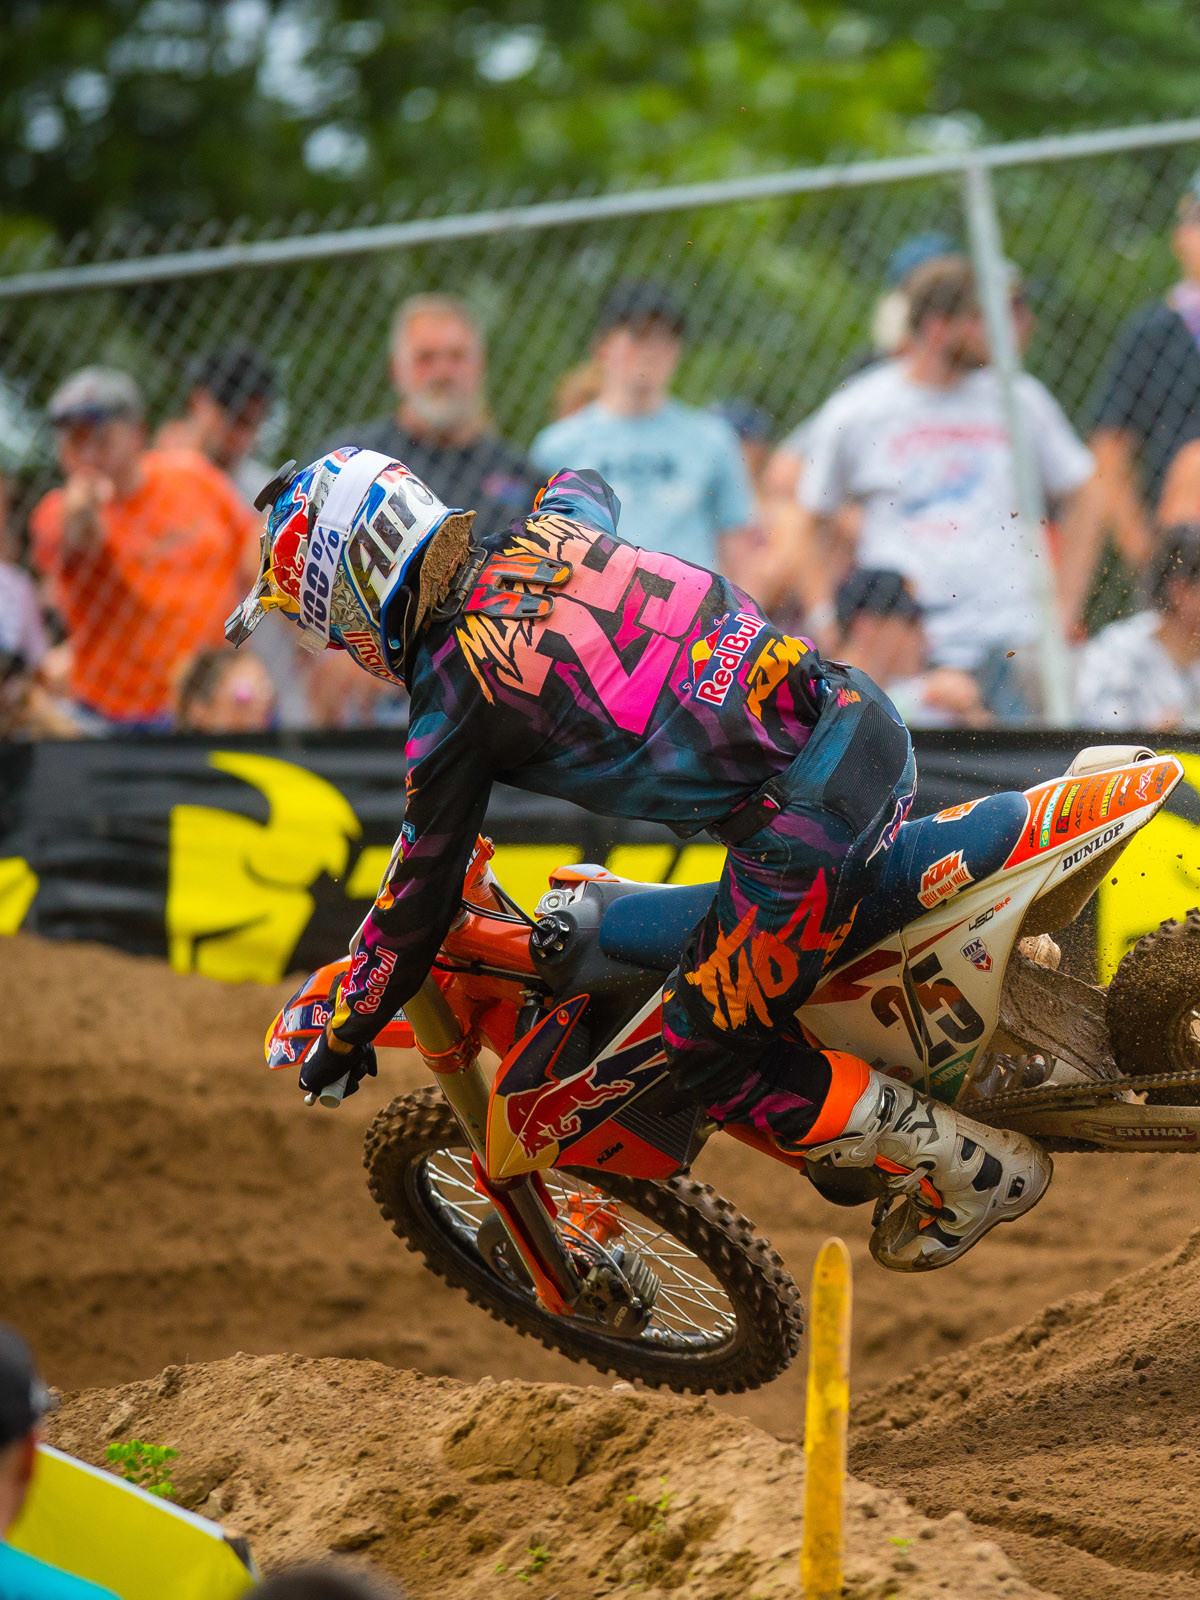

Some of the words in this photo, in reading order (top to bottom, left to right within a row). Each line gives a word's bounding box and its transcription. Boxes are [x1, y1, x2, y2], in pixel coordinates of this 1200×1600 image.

[301, 526, 341, 633] 100%
[497, 536, 713, 735] 25
[747, 635, 808, 722] KTM
[922, 851, 962, 892] KTM
[1063, 822, 1125, 871] DUNLOP
[968, 907, 994, 931] 450
[871, 952, 985, 1068] 25
[597, 1142, 624, 1165] KTM
